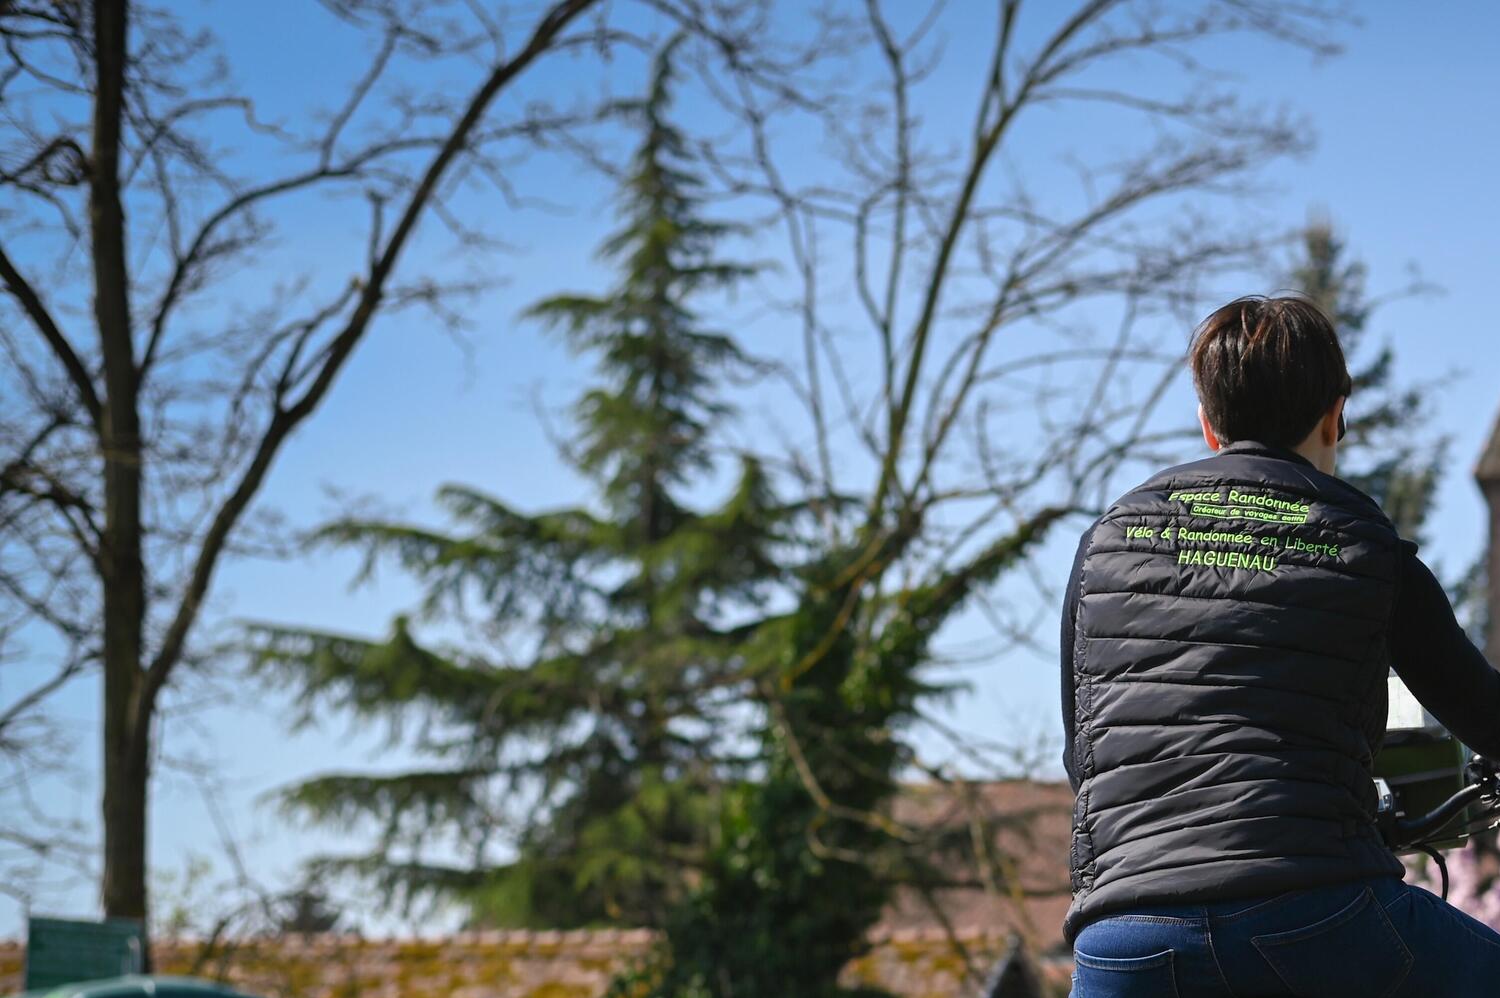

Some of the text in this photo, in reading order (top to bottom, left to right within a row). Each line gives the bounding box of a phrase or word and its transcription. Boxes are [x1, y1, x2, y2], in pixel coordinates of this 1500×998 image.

[1168, 490, 1310, 513] Espace Randonnée
[1193, 505, 1227, 515] Créateur
[1230, 507, 1241, 516] de
[1244, 510, 1278, 520] voyages
[1126, 526, 1339, 557] Vélo & Randonnée en Liberté
[1178, 549, 1275, 572] HAGUENAU
